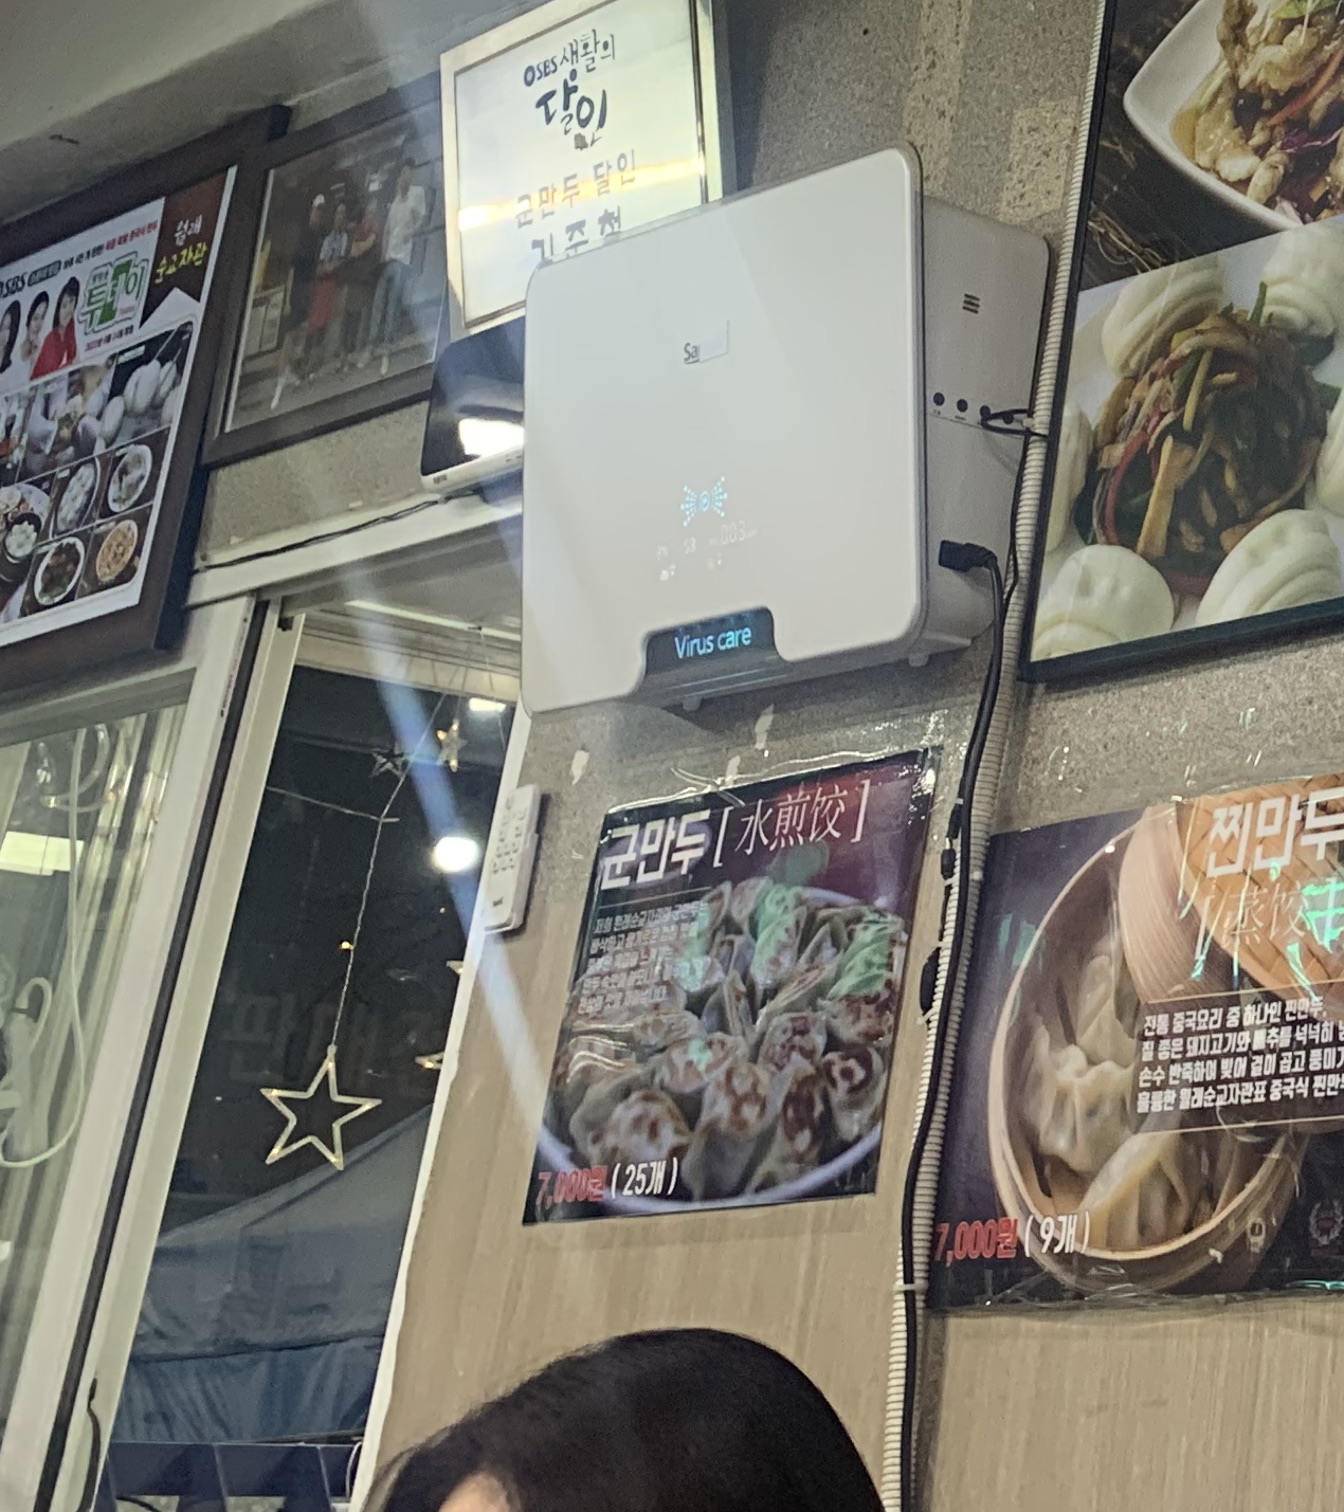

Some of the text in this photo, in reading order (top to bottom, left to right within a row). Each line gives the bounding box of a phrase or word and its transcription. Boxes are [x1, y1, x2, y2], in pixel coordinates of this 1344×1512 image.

[560, 30, 615, 73] 생활의
[535, 69, 608, 148] 달인
[514, 149, 636, 229] 군만두 달인
[674, 627, 752, 659] Virus care
[600, 807, 711, 891] 군만두
[1173, 1008, 1222, 1031] 중국요리
[1186, 1031, 1250, 1057] 돼지고기와
[934, 1217, 1018, 1268] 7,000원
